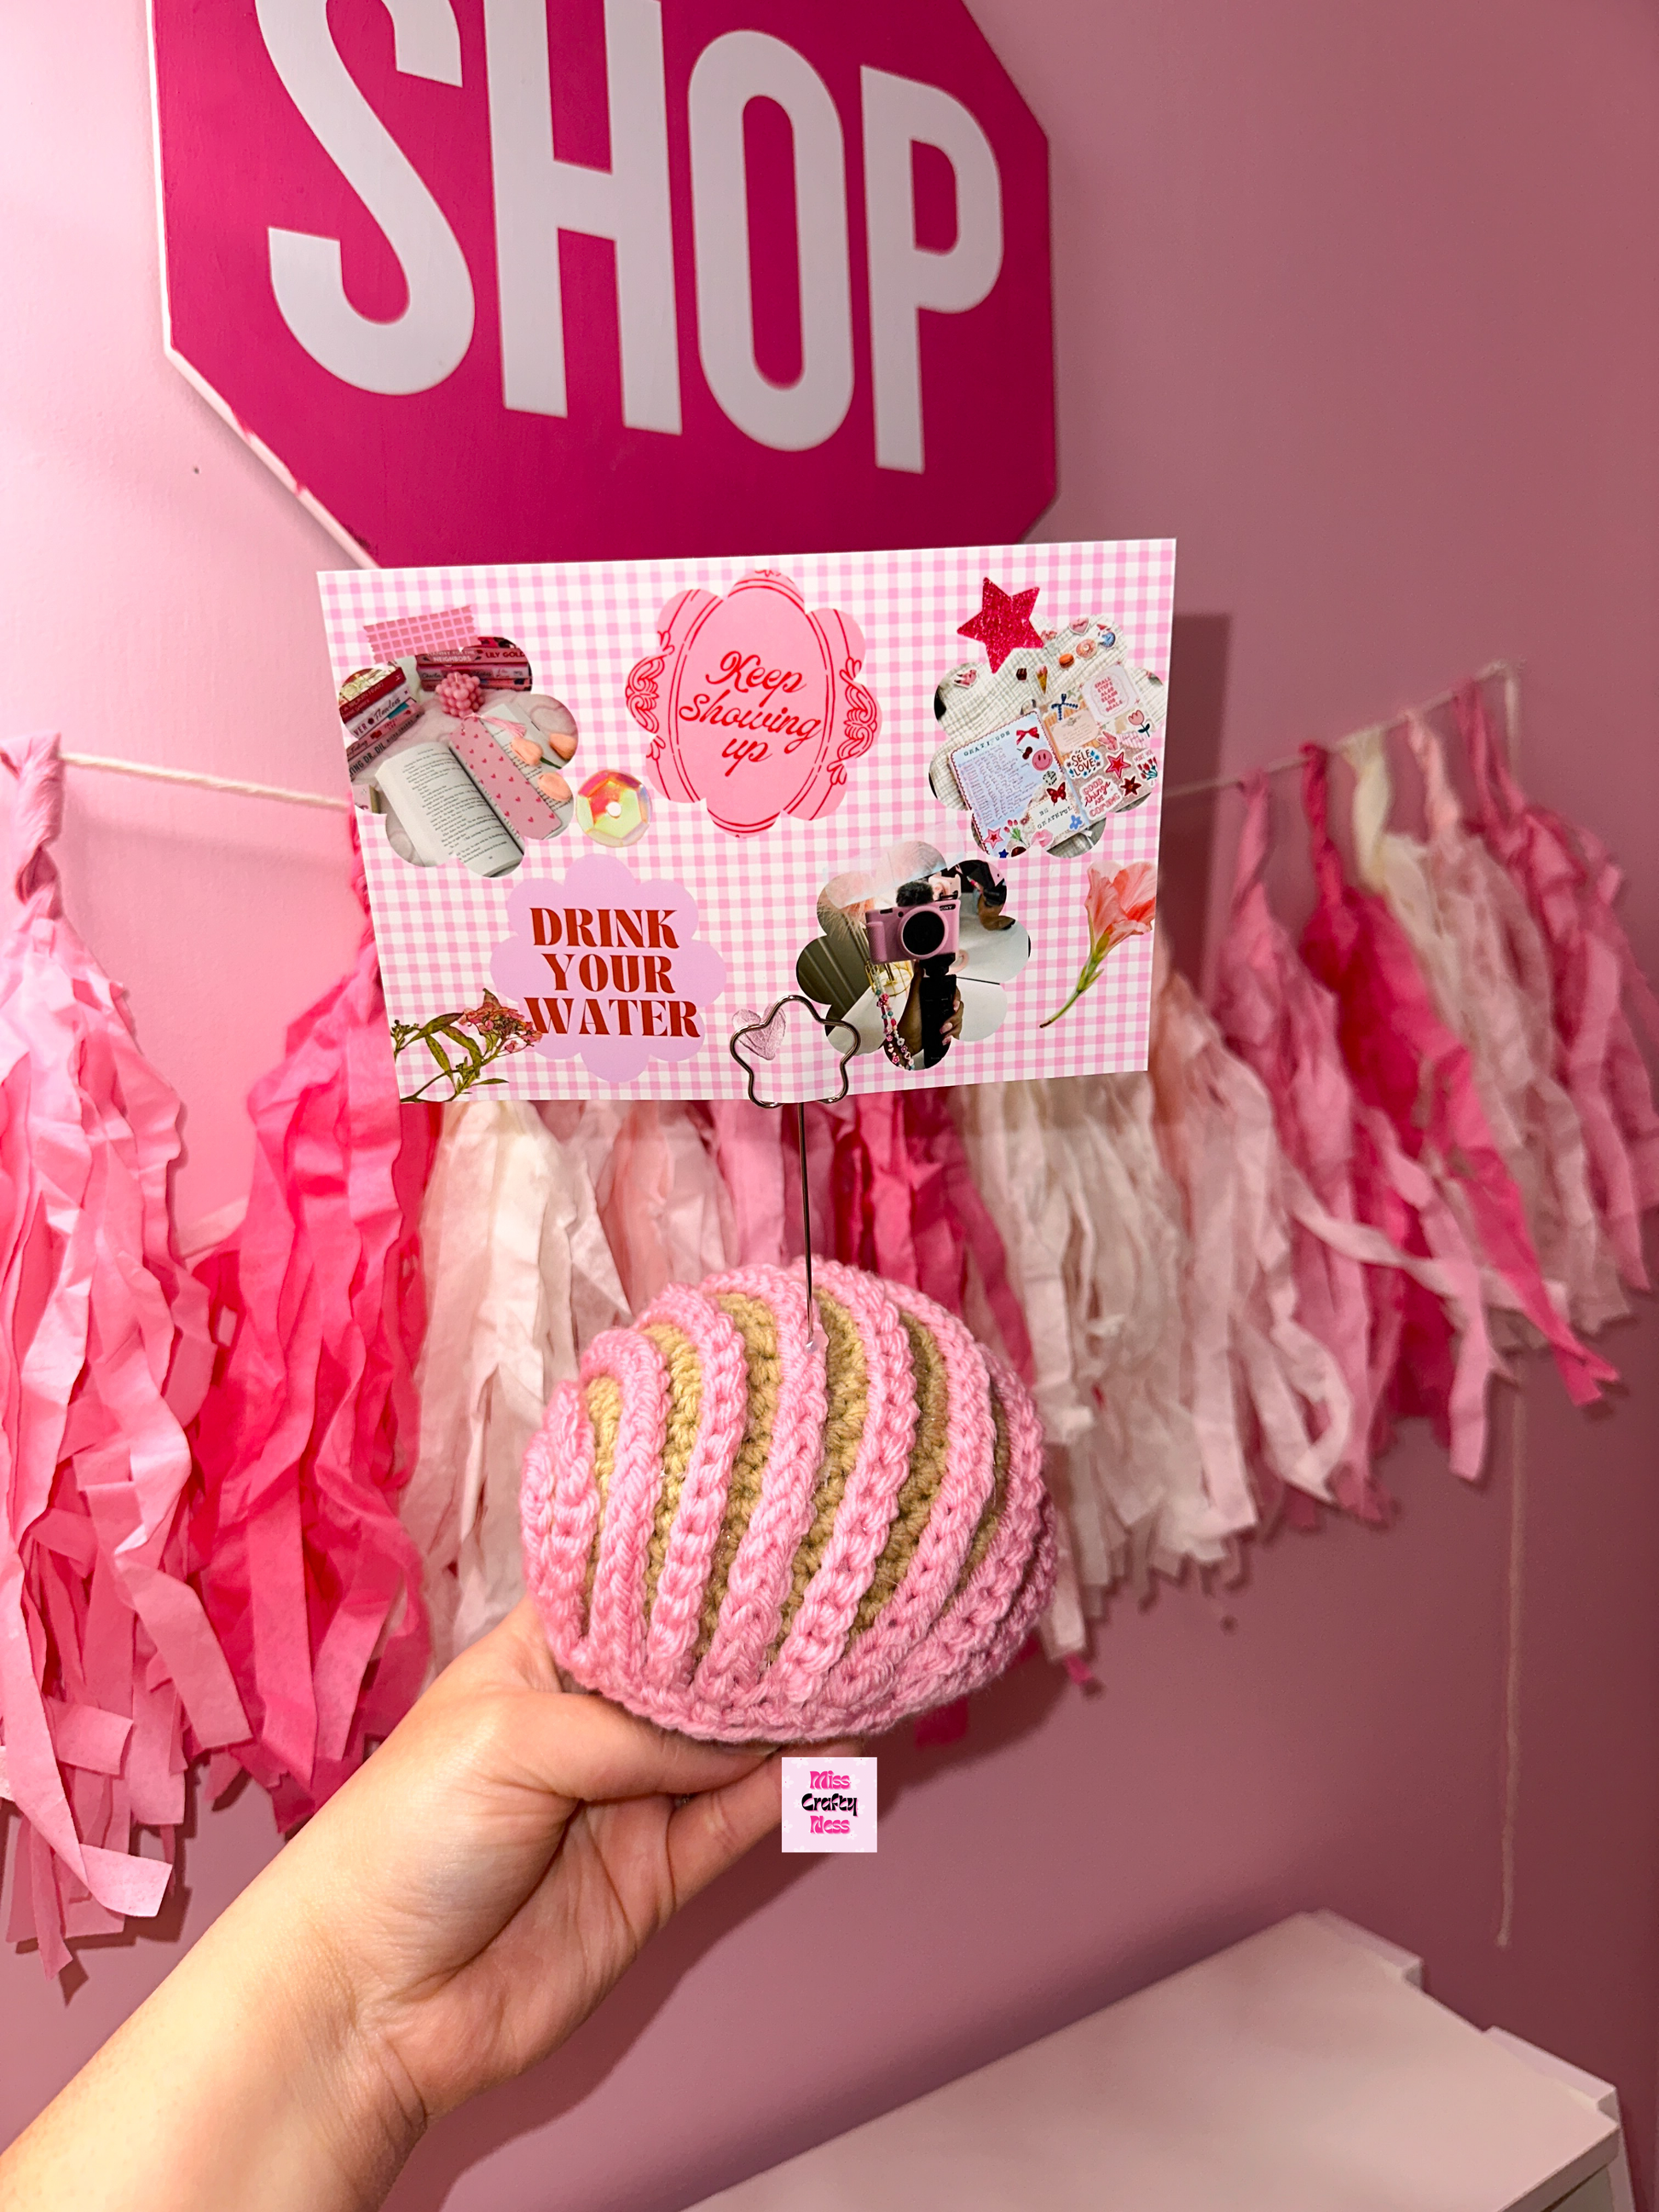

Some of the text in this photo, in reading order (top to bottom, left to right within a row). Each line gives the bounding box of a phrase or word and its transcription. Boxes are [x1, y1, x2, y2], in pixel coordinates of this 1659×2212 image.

[255, 0, 1004, 474] SHOP
[705, 650, 807, 707] Keep
[1095, 676, 1112, 689] SMALL
[1097, 681, 1113, 693] STEPS
[1101, 686, 1114, 697] ALSO
[1105, 699, 1124, 713] GOALS
[679, 690, 822, 754] Showing
[375, 742, 387, 754] DIL
[963, 731, 1010, 757] GRATITUDE
[721, 738, 772, 777] up
[1071, 749, 1090, 766] SELF
[1072, 758, 1095, 777] LOVE
[1082, 777, 1103, 795] GOOD
[1084, 781, 1111, 807] things
[1089, 793, 1120, 817] COMING
[1095, 794, 1105, 806] ARE
[1037, 806, 1072, 829] GRATEFUL
[529, 908, 679, 949] DRINK
[540, 953, 676, 994] YOUR
[523, 997, 701, 1037] WATER
